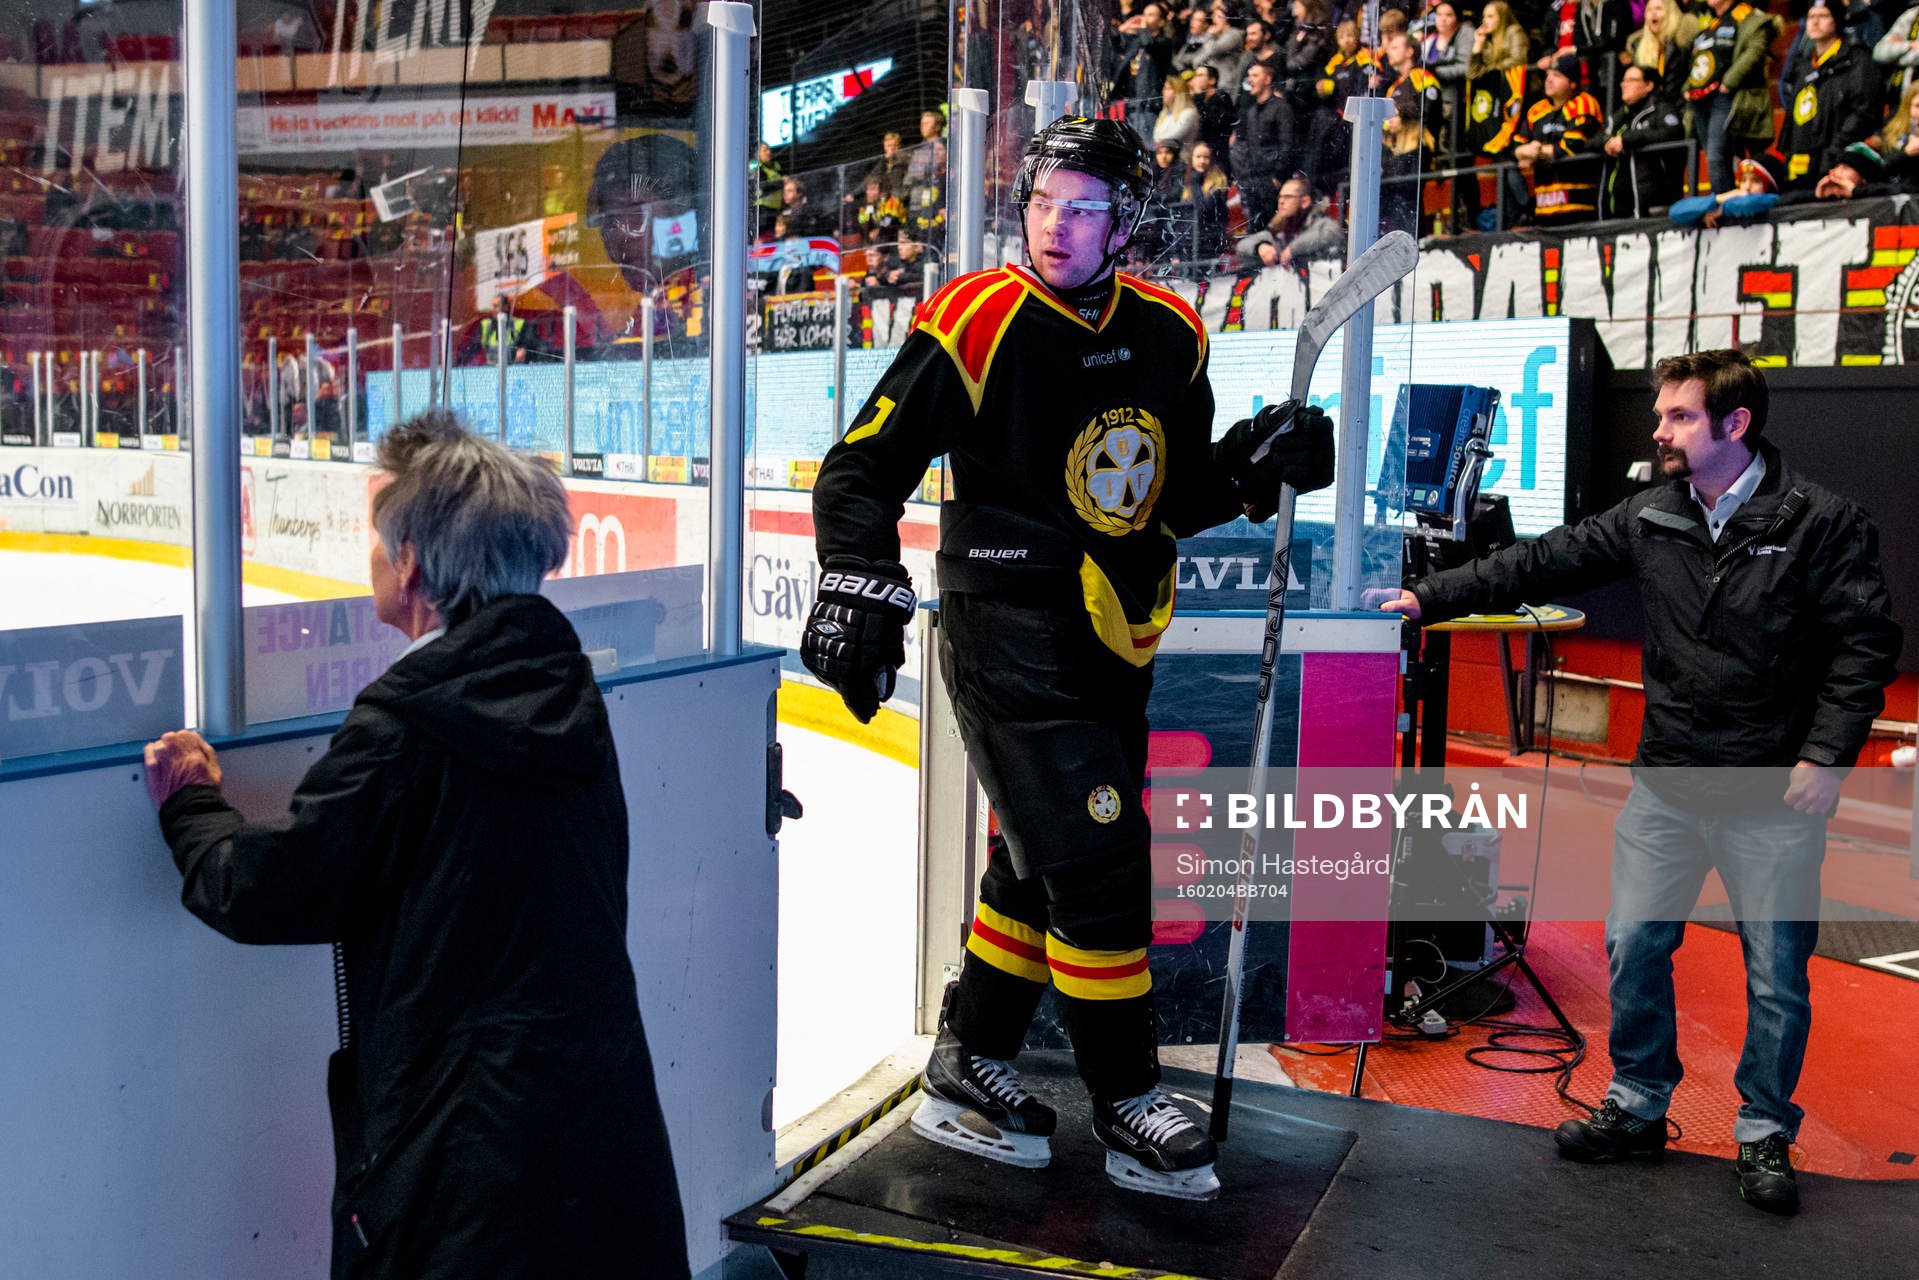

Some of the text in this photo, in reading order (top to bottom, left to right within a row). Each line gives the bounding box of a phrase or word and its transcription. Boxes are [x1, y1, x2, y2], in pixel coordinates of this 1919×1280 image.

[1082, 349, 1118, 368] unicef
[1101, 406, 1135, 428] 1912
[1446, 408, 1471, 490] creamsource
[97, 499, 181, 529] NORRPORTEN
[968, 548, 1028, 559] BAUER
[750, 554, 817, 622] Gävl
[1176, 556, 1306, 591] LVIA
